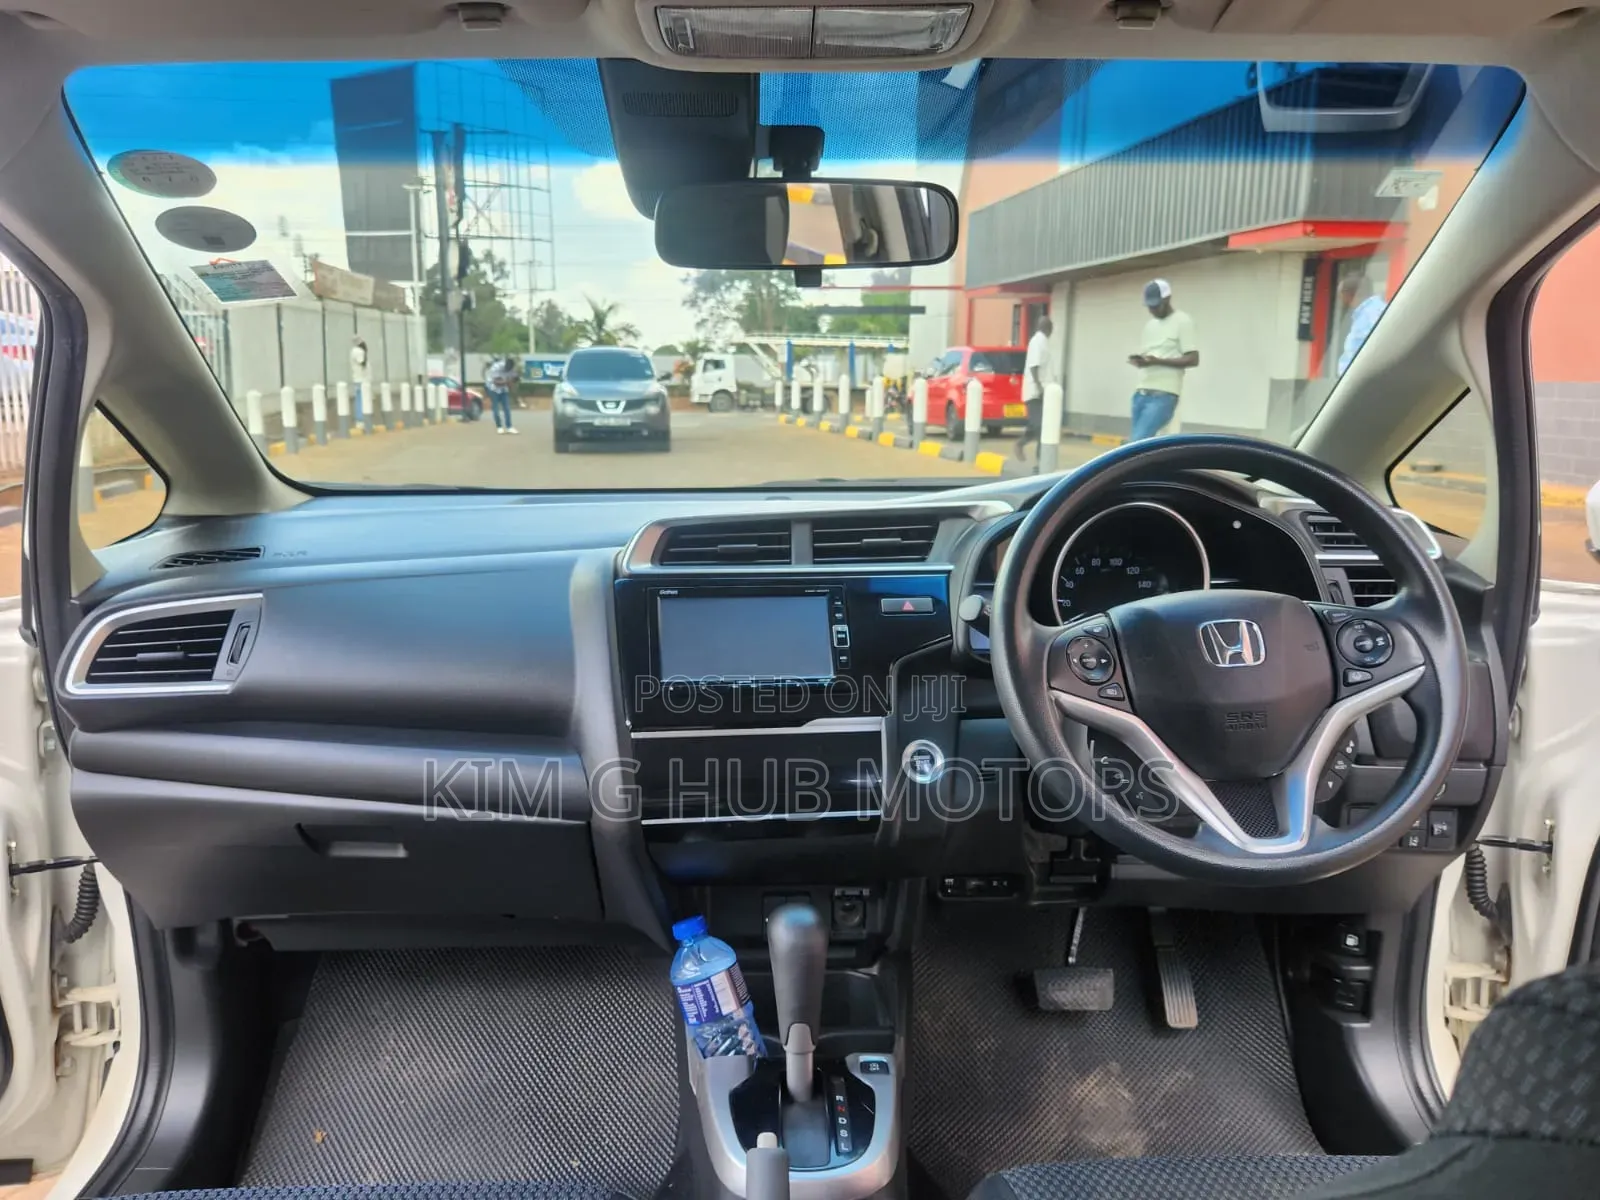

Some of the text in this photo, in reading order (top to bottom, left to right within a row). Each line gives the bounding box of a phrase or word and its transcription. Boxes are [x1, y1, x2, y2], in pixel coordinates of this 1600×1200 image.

[1301, 276, 1312, 324] PAY HERE
[1091, 558, 1101, 567] 80
[1075, 567, 1085, 575] 60
[1126, 566, 1140, 575] 120
[1065, 580, 1074, 589] 40
[1138, 580, 1152, 589] 140
[1062, 599, 1071, 607] 20
[841, 1142, 849, 1151] L
